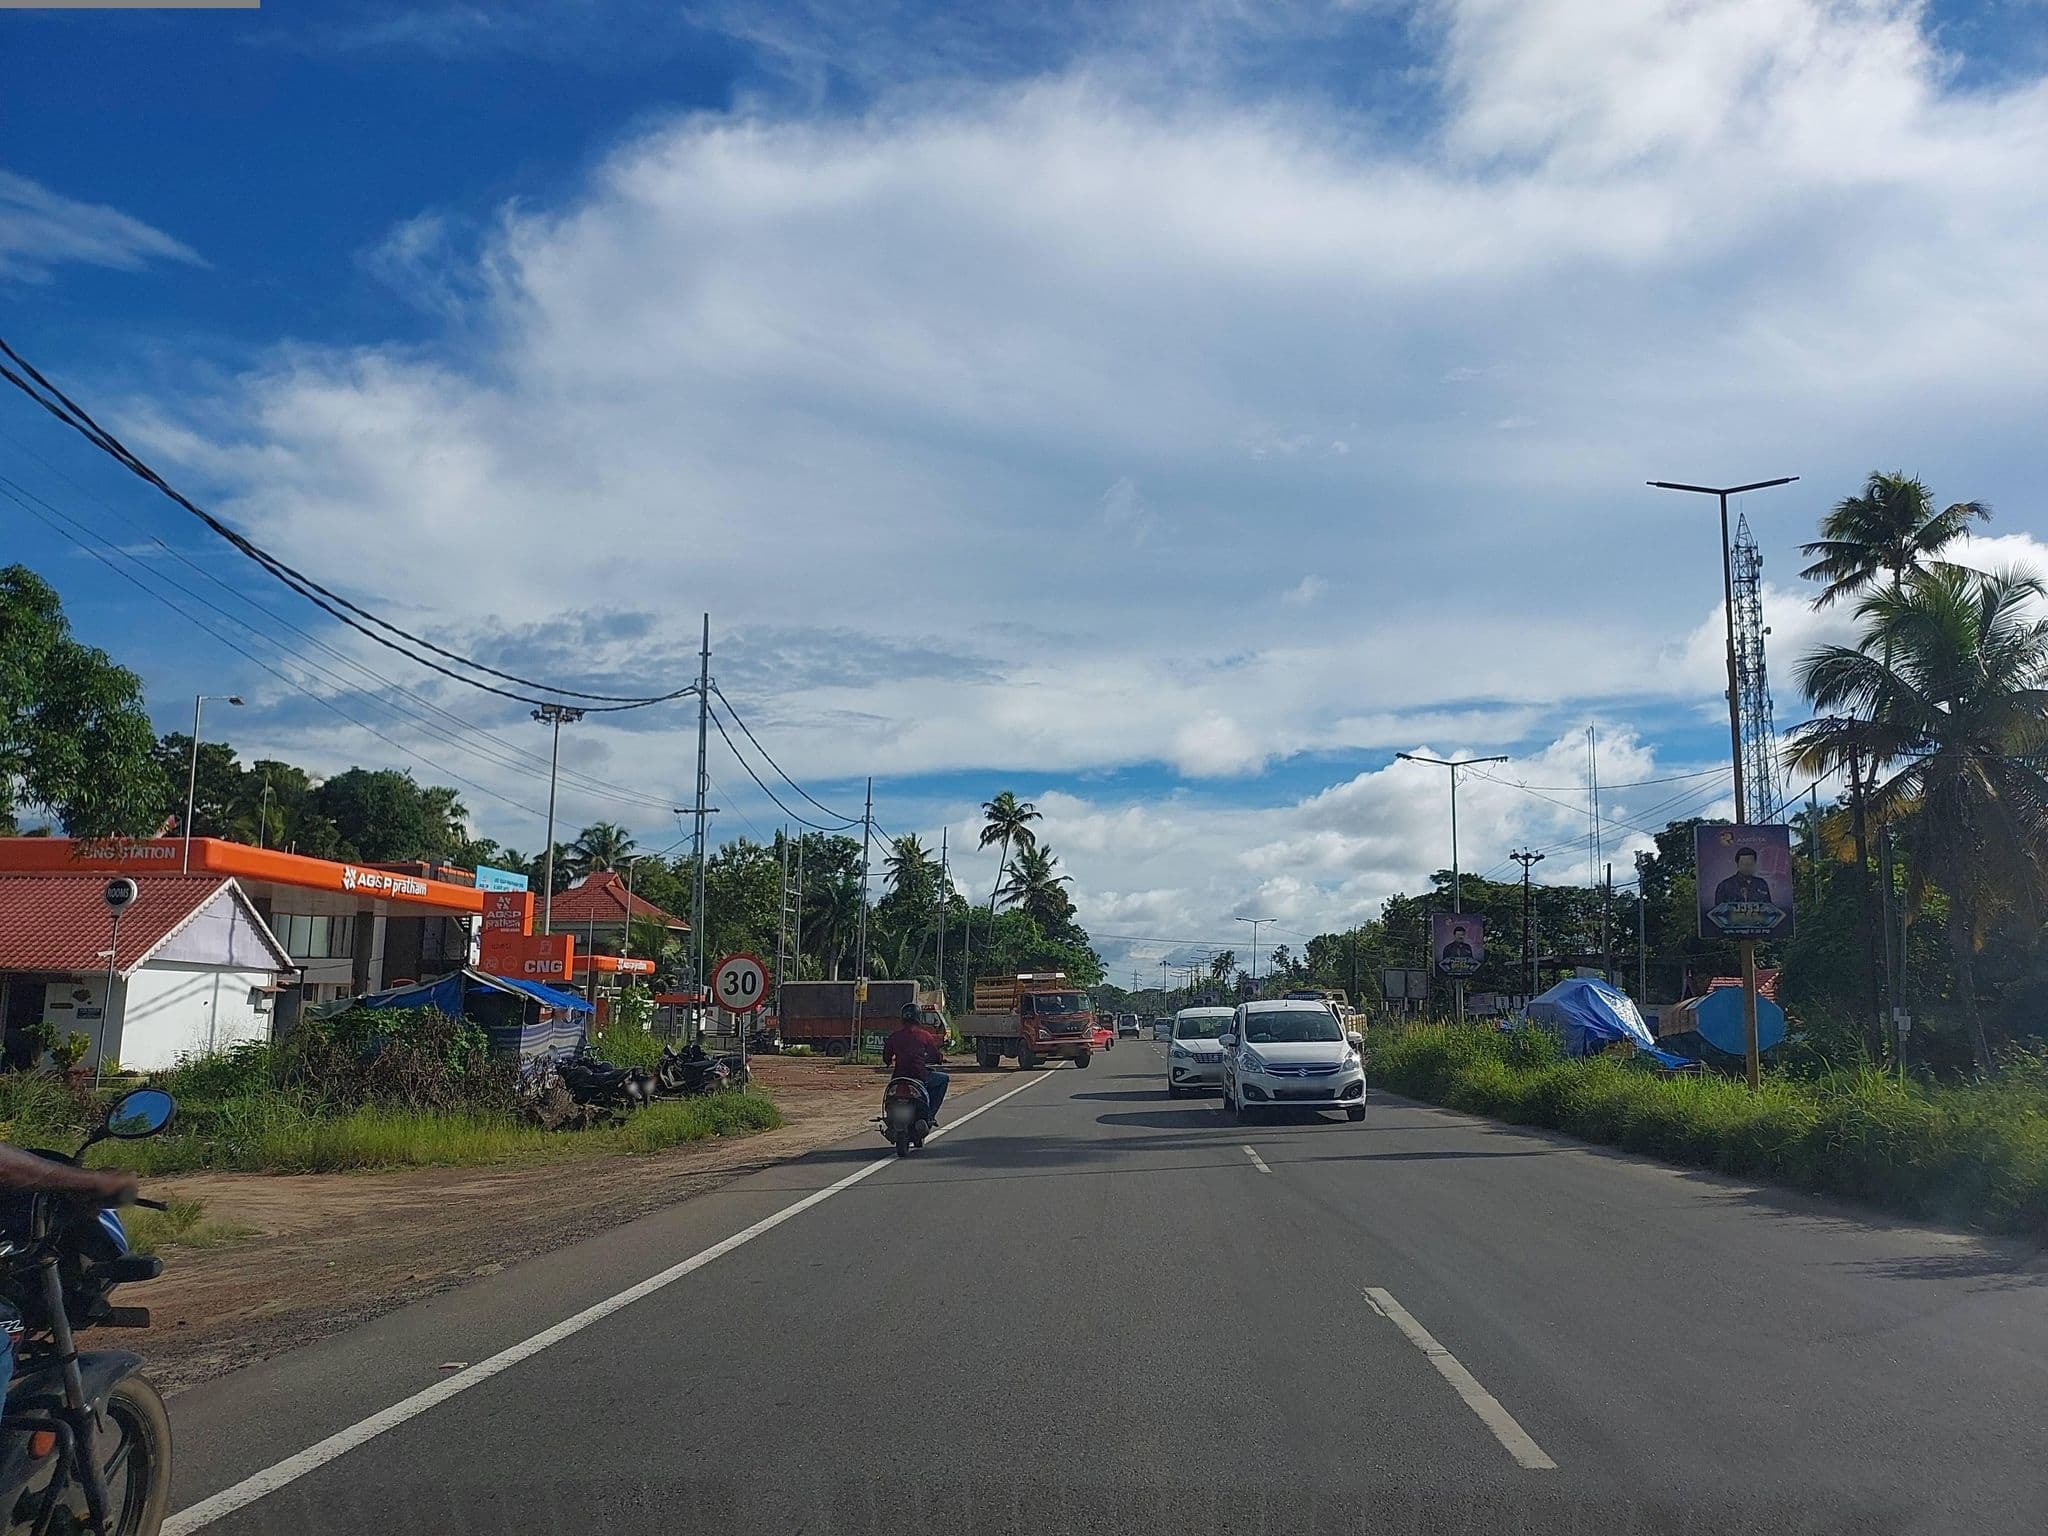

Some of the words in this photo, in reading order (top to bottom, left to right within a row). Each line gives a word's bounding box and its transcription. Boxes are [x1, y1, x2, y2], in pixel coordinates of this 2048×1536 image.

[120, 846, 176, 859] STATION
[357, 872, 393, 890] AG&P
[107, 887, 130, 898] ROOMS
[524, 960, 563, 974] CNG
[723, 970, 757, 996] 30
